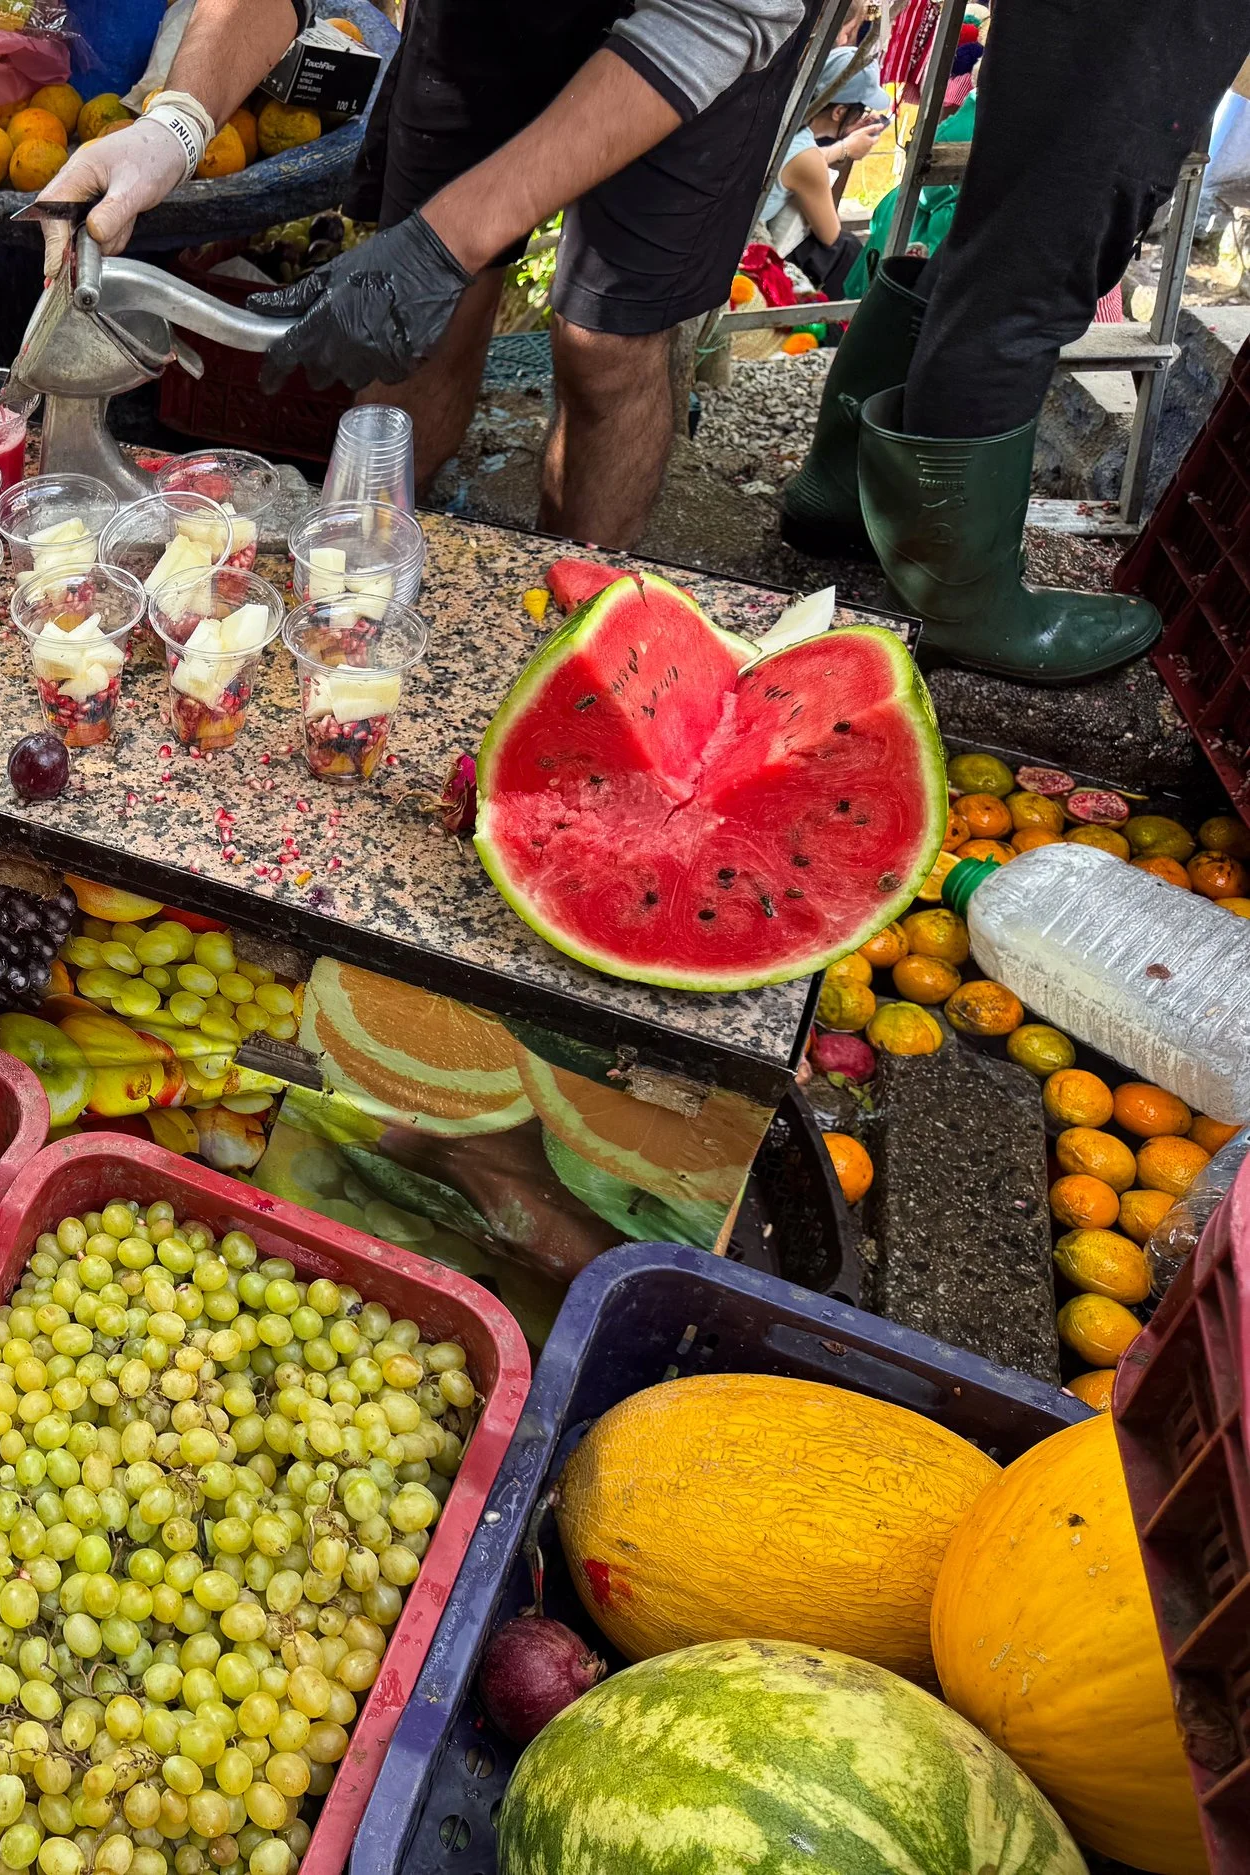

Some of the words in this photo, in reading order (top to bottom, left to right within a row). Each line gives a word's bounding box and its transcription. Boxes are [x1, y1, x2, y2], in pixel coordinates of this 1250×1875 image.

[304, 58, 337, 72] TouchFlex
[336, 100, 349, 111] 100
[351, 99, 357, 110] L
